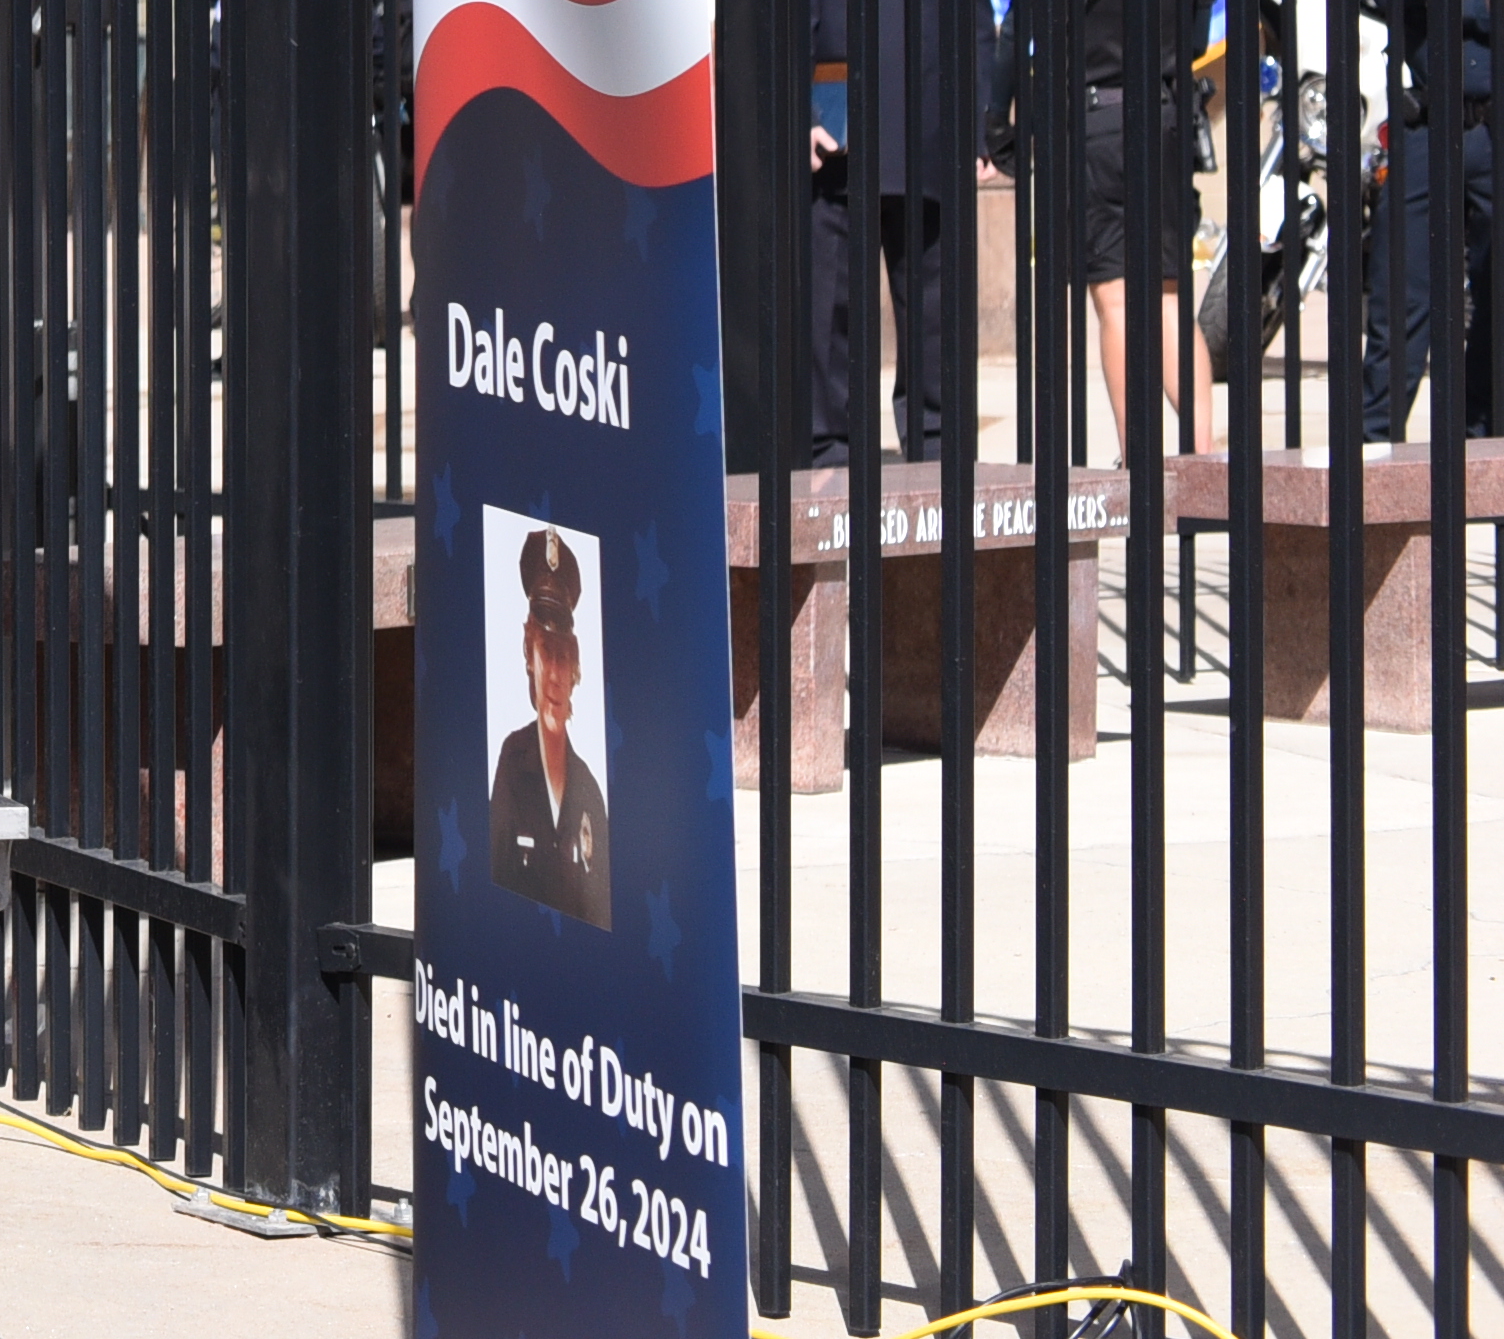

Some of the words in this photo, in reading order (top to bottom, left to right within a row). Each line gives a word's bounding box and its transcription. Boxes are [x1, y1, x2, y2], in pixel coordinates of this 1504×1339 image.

[448, 302, 524, 403] Dale
[532, 322, 630, 430] Coski
[415, 958, 465, 1048] Died
[471, 985, 497, 1063] in
[503, 999, 555, 1090] line
[562, 1035, 594, 1107] of
[600, 1045, 674, 1161] Duty
[681, 1101, 728, 1167] on
[424, 1075, 573, 1211] September
